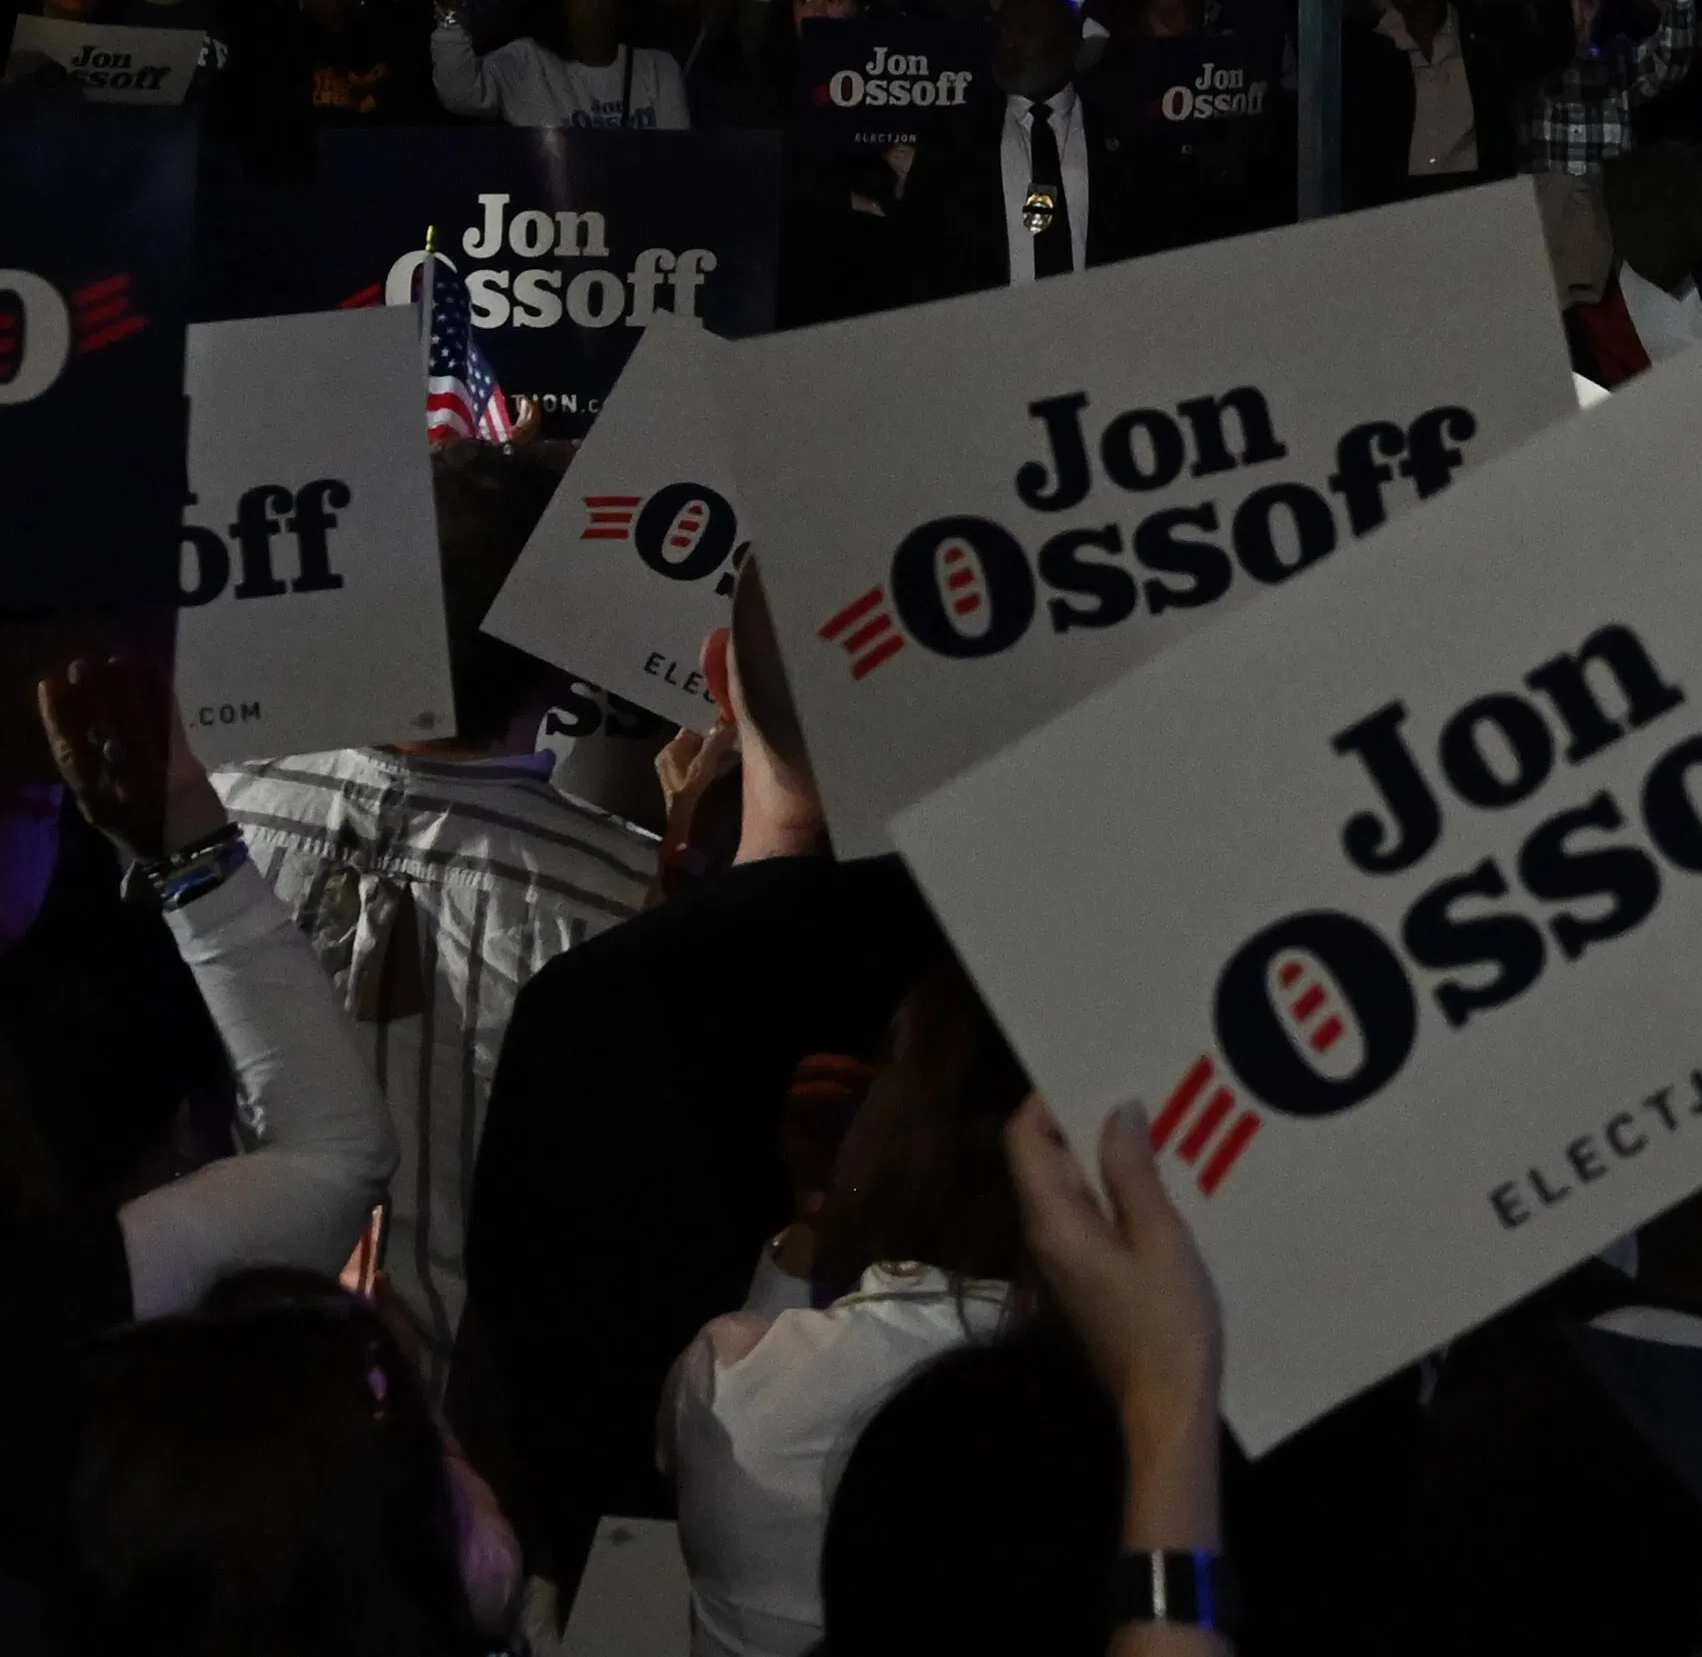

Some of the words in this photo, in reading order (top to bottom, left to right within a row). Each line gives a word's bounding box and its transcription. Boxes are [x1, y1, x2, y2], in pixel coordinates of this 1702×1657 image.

[70, 44, 132, 70] Jon
[827, 71, 973, 107] Ossoff
[865, 46, 930, 78] Jon
[461, 192, 611, 259] Jon
[1010, 382, 1290, 515] Jon
[889, 402, 1480, 663] Ossoff
[1329, 618, 1690, 879] Jon
